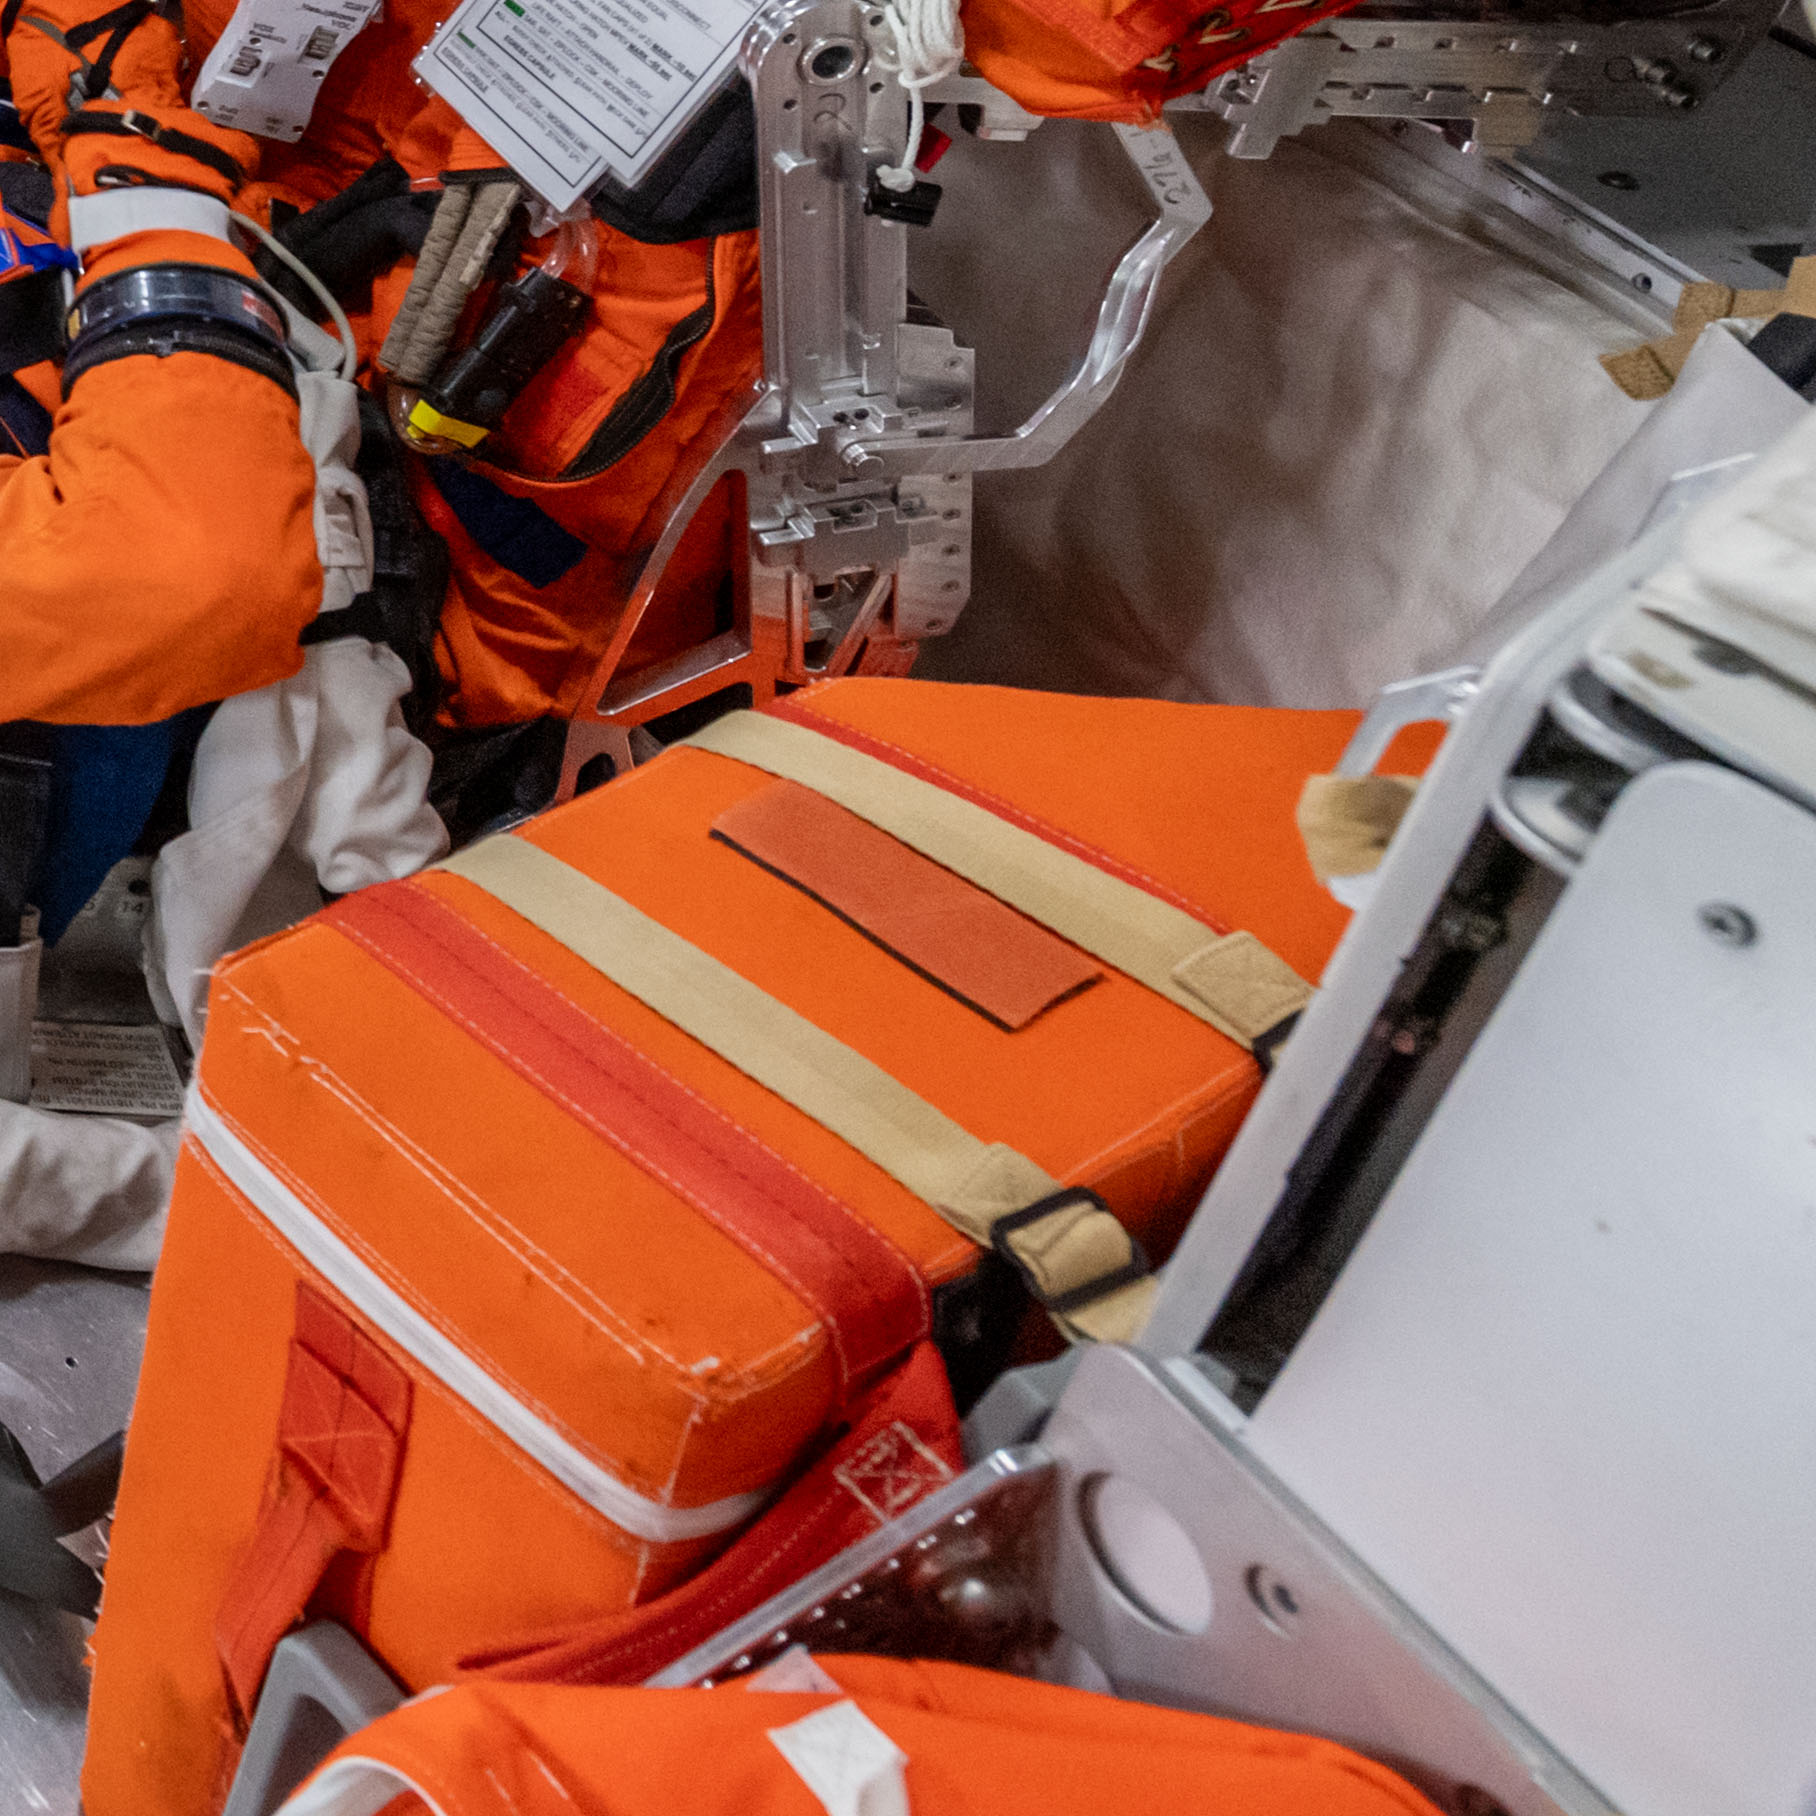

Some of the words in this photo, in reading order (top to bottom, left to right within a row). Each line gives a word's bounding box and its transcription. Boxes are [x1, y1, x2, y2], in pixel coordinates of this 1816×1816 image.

[578, 21, 600, 40] OPEN
[502, 33, 530, 58] EGRESS
[526, 53, 556, 80] CAPSULE
[626, 41, 650, 63] MARK
[649, 41, 673, 63] MARK
[623, 75, 654, 102] DEPLOY
